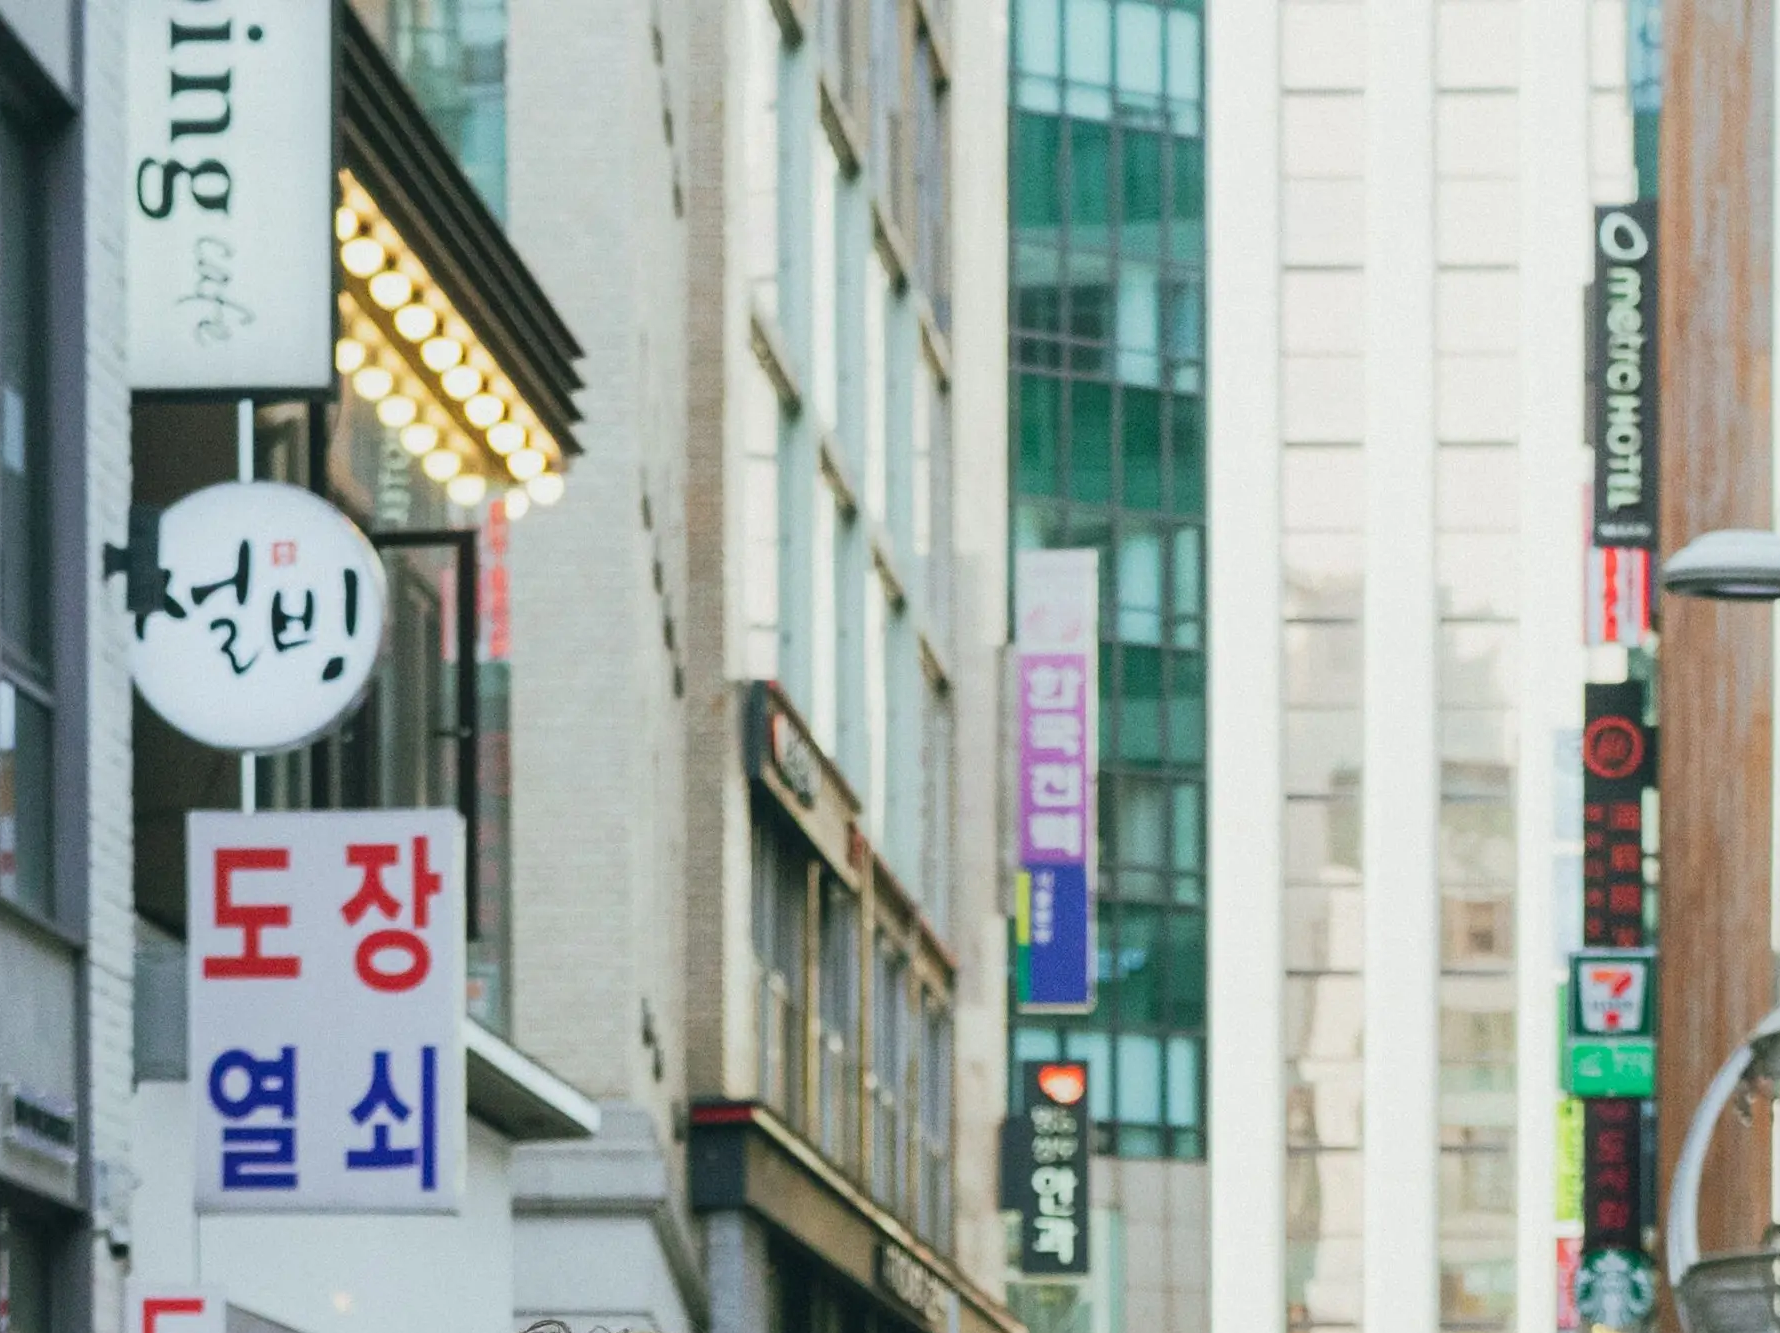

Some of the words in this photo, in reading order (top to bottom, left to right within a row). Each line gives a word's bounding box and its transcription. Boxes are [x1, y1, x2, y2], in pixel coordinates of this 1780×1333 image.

[136, 0, 264, 219] ing
[176, 235, 256, 346] cafe
[204, 836, 442, 992] 도장
[208, 1044, 439, 1192] 열쇠
